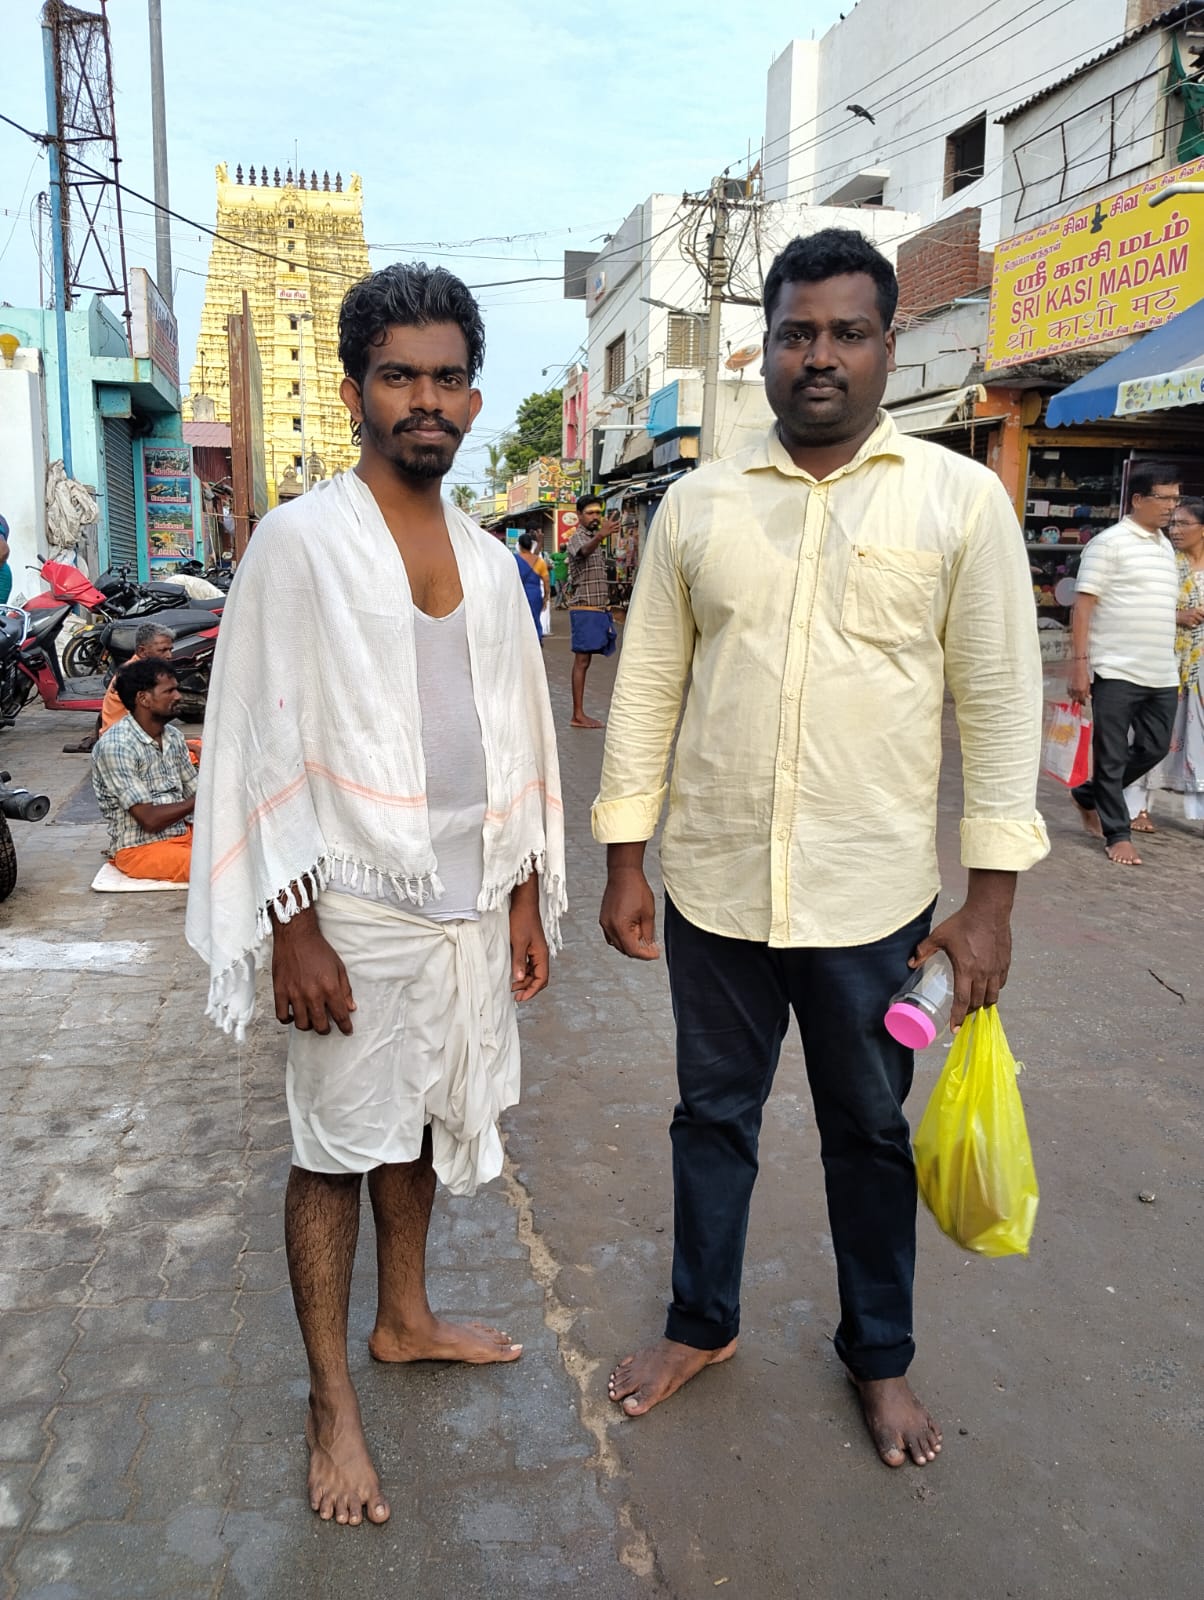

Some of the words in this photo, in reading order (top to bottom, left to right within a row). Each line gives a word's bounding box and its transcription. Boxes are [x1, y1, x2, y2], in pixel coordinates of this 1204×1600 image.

[1053, 239, 1111, 278] காசி
[1118, 212, 1189, 257] மடம்
[1062, 214, 1088, 236] சிவ
[1110, 194, 1139, 217] சிவ
[1011, 295, 1040, 325] SRI
[1046, 277, 1092, 313] KASI
[1100, 245, 1188, 297] MADAM
[1006, 325, 1037, 349] श्री
[1048, 300, 1117, 339] काशी
[1132, 287, 1179, 315] मठ
